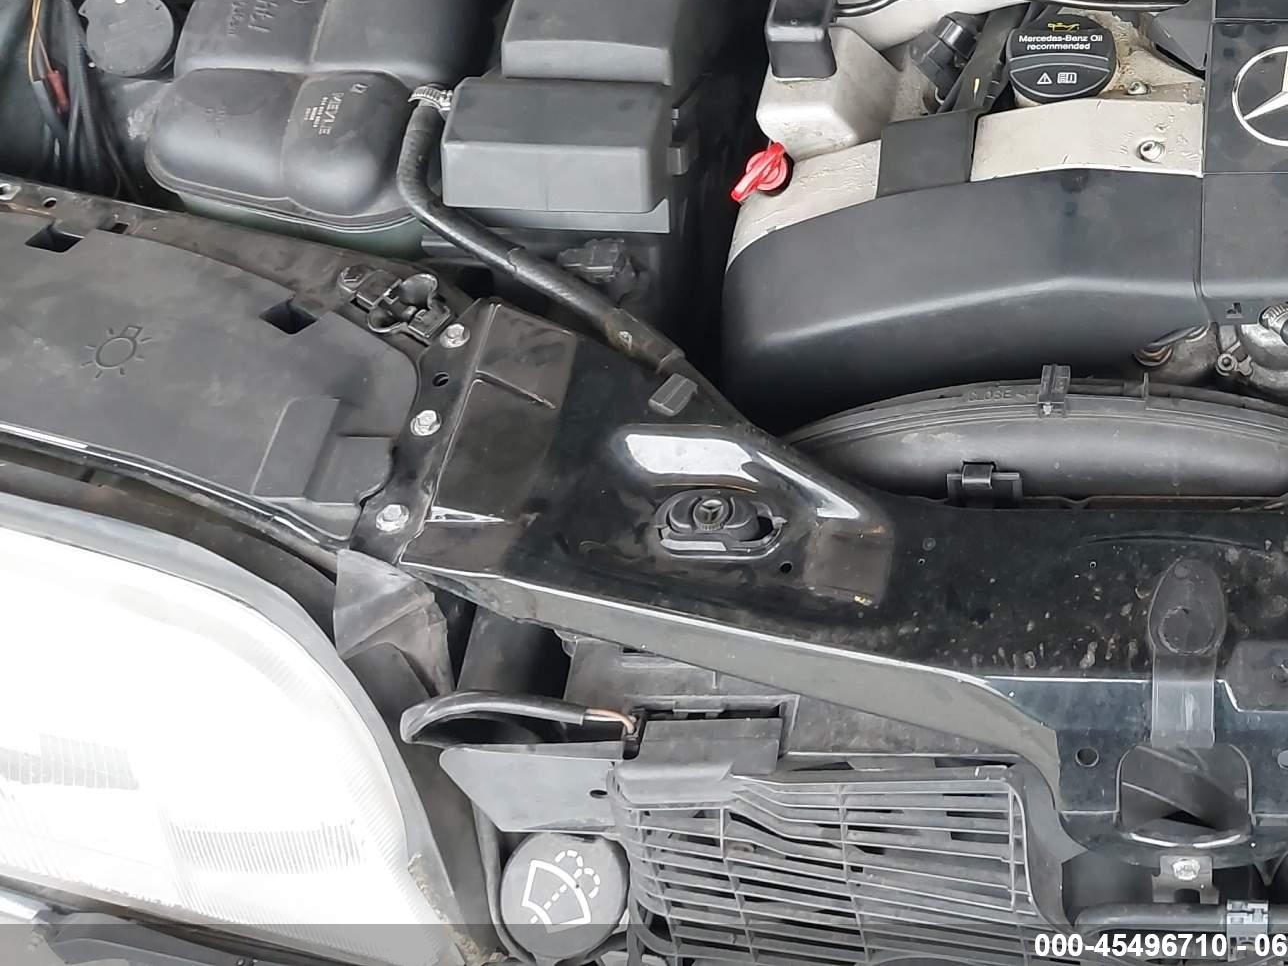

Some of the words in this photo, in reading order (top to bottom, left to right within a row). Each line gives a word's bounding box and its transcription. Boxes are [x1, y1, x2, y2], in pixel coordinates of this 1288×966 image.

[1018, 34, 1089, 43] Mercedes-Benz
[1090, 35, 1103, 43] Oil
[1026, 42, 1091, 51] recommended
